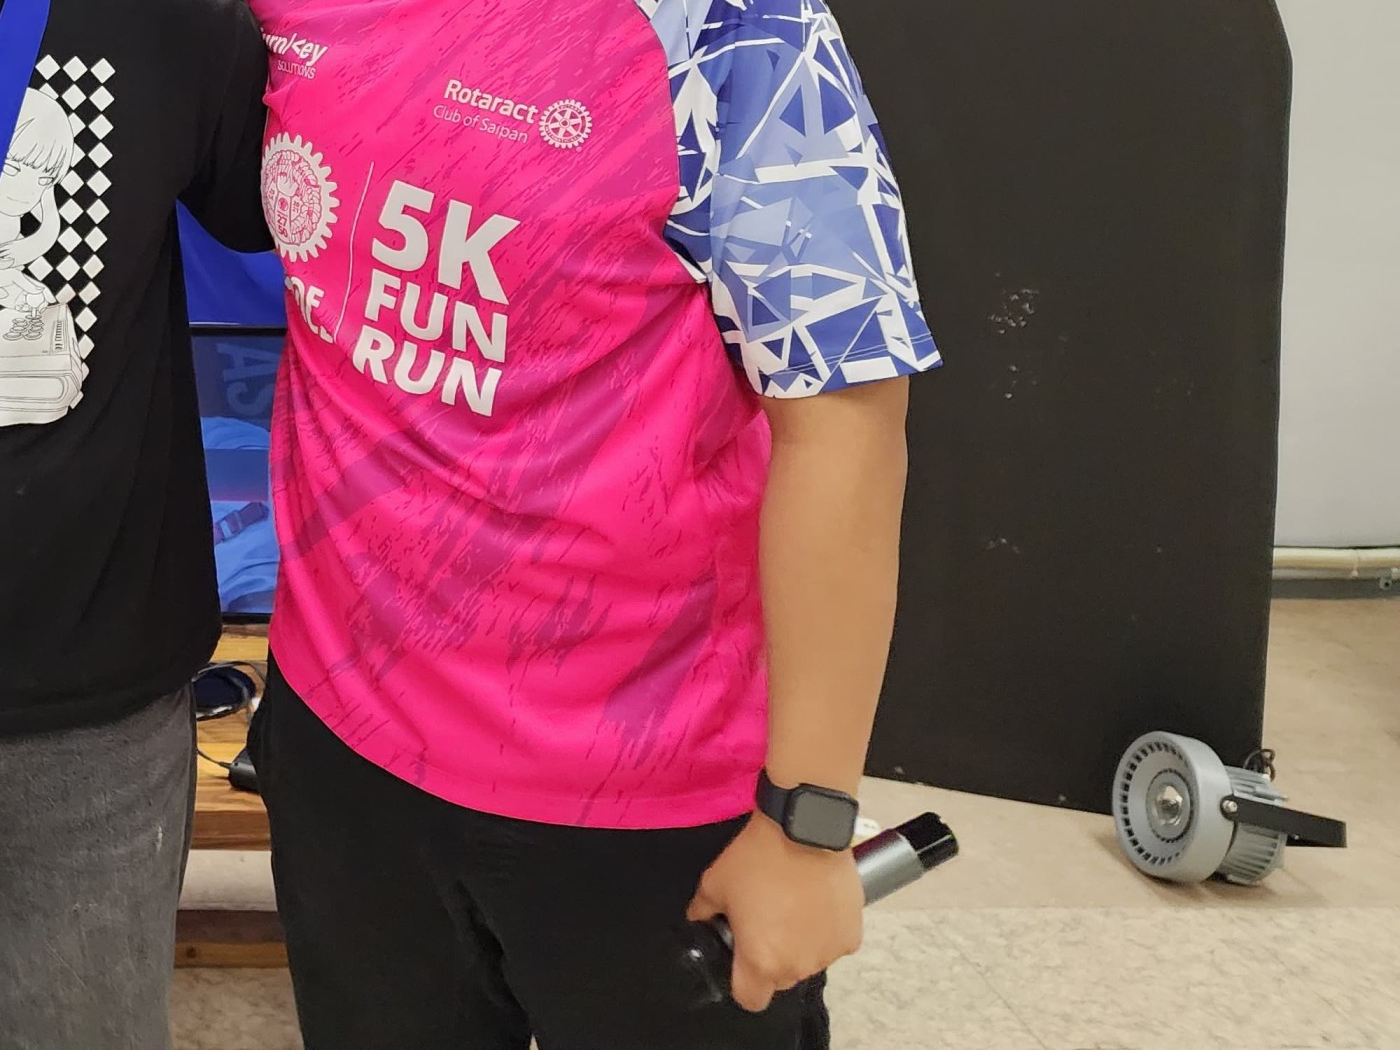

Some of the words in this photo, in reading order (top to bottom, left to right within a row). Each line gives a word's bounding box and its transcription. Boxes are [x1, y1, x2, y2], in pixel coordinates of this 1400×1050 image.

[433, 104, 462, 123] Club
[463, 115, 480, 128] of
[479, 118, 528, 144] Saipan
[444, 79, 538, 124] Rotaract
[371, 179, 521, 305] 5K
[364, 268, 508, 363] FUN
[352, 324, 503, 417] RUN
